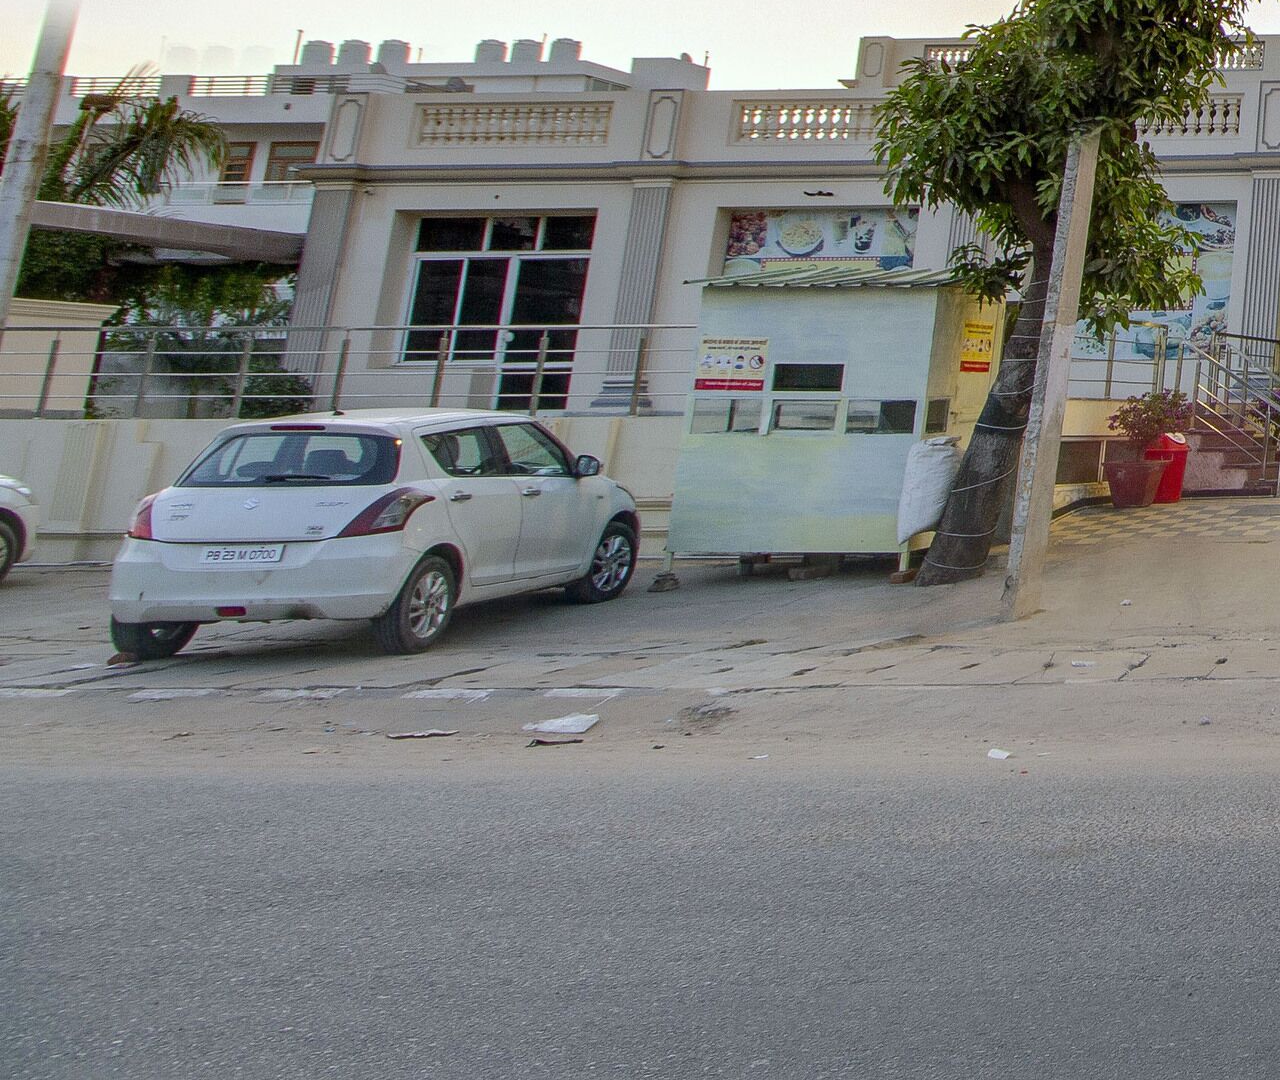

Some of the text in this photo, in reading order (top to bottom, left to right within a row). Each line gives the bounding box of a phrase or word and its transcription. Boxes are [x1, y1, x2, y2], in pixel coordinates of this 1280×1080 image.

[206, 549, 275, 560] PB 23 M 0700
